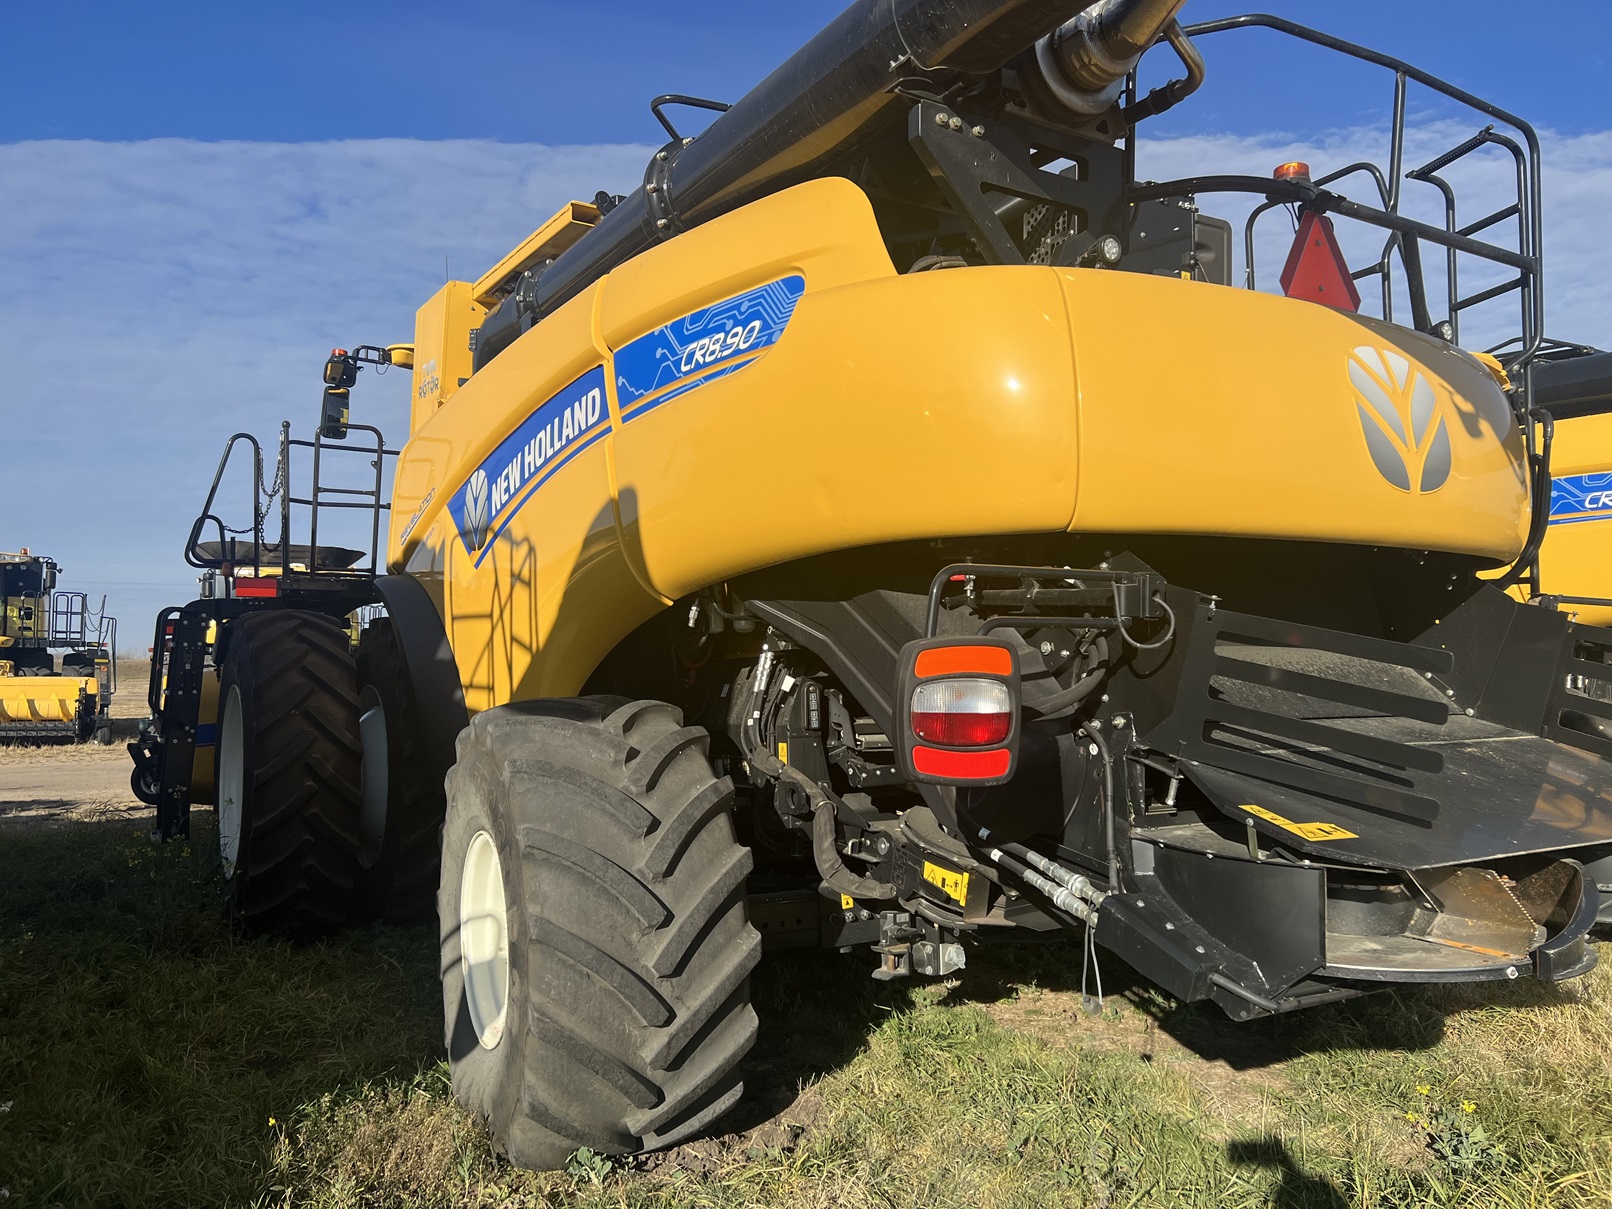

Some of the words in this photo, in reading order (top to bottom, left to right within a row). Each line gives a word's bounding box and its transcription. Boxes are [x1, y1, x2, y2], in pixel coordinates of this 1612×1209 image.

[680, 319, 762, 373] CR8.90
[418, 375, 440, 399] ROTOR
[491, 452, 522, 517] NEW
[524, 387, 601, 480] HOLLAND
